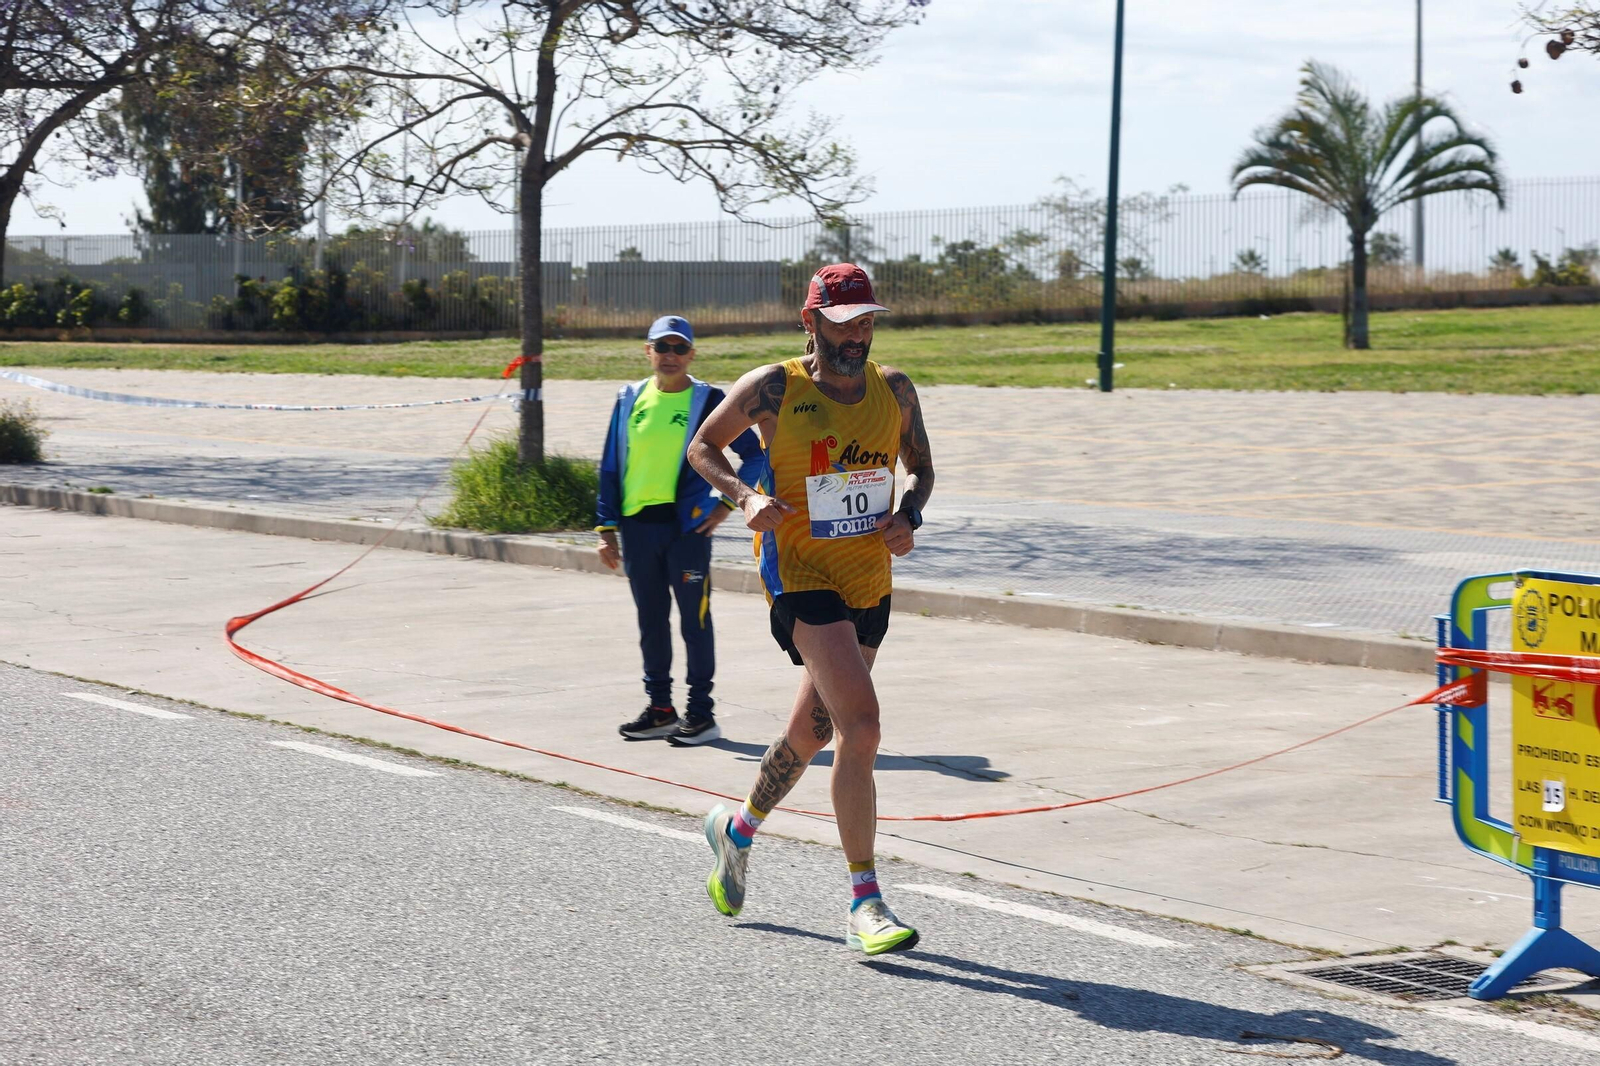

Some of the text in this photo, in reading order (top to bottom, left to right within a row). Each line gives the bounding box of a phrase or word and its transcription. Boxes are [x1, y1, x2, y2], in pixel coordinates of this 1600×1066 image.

[794, 402, 818, 414] vive
[841, 492, 868, 516] 10
[1580, 630, 1600, 654] M
[1517, 744, 1581, 765] PROHIBIDO
[1517, 779, 1540, 793] LAS
[1544, 786, 1562, 804] 15
[1518, 814, 1543, 829] CON
[1545, 819, 1589, 838] MOTIVO
